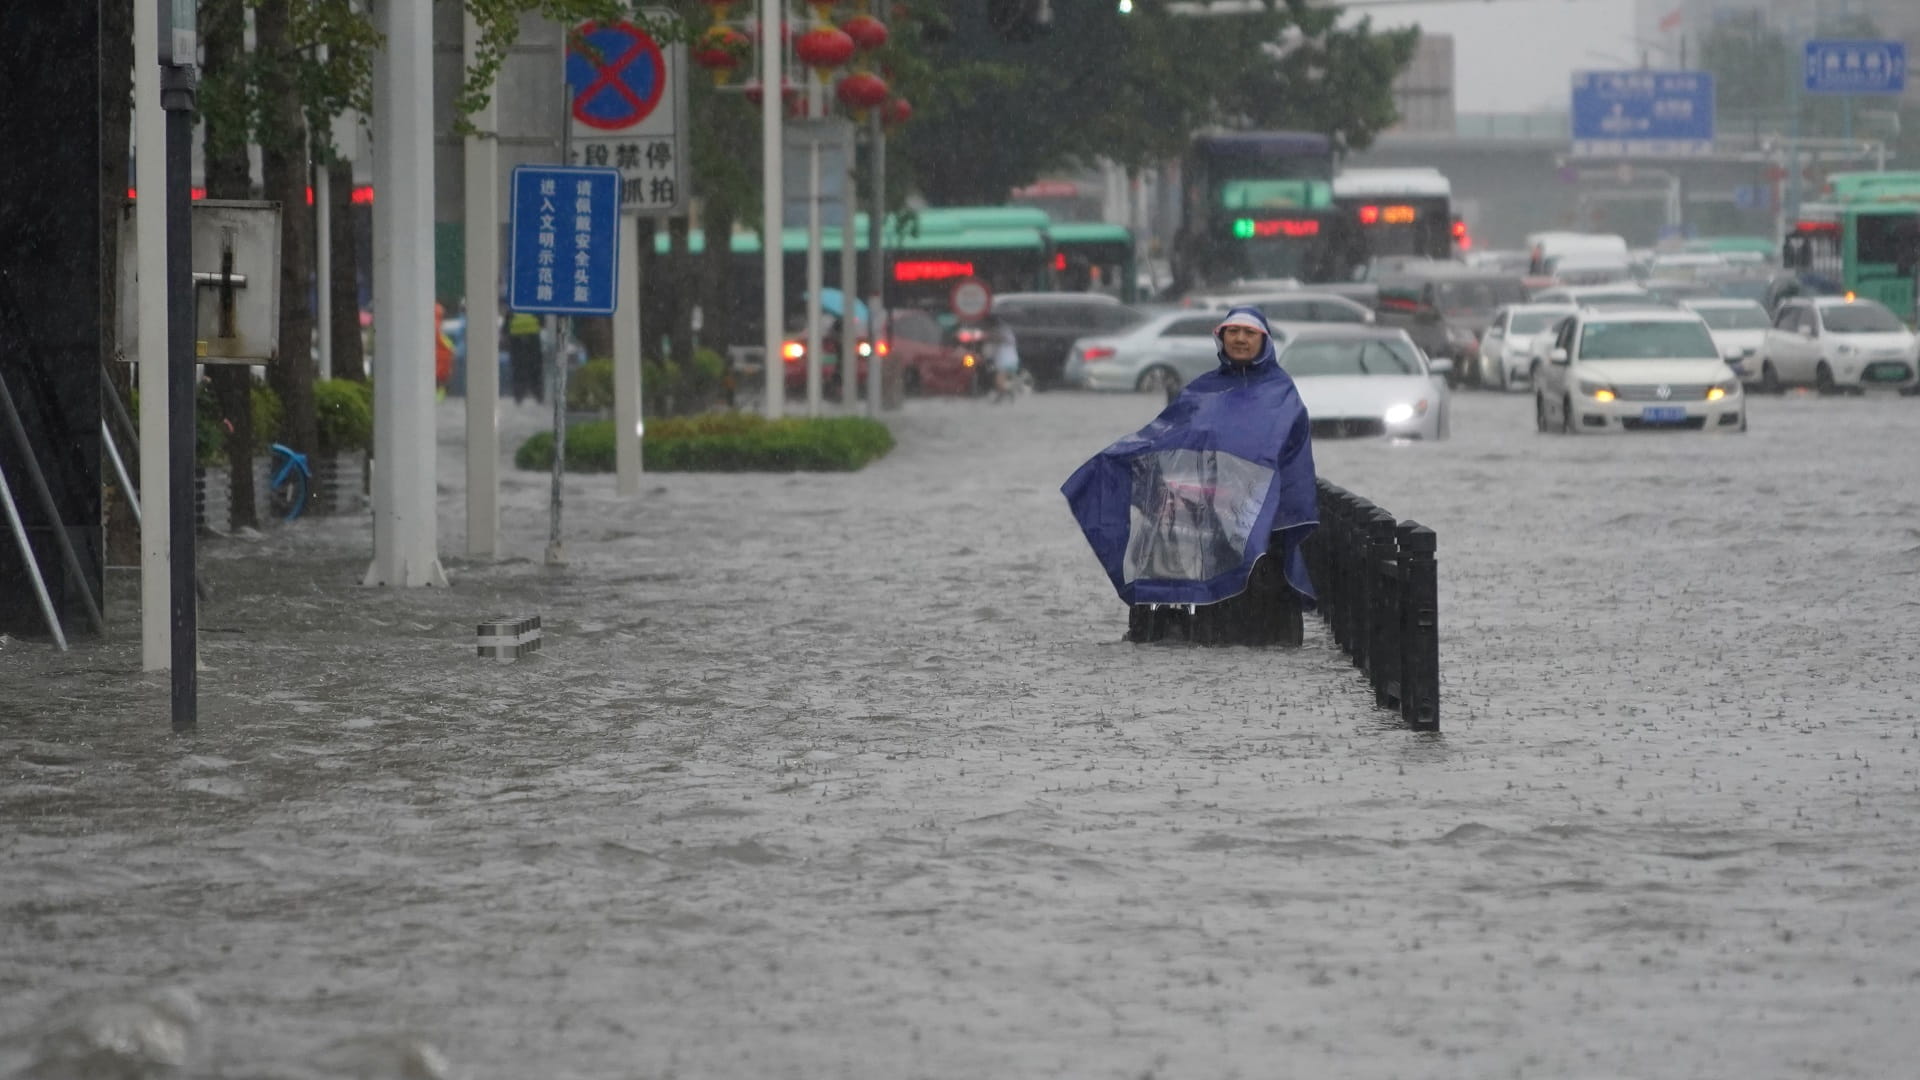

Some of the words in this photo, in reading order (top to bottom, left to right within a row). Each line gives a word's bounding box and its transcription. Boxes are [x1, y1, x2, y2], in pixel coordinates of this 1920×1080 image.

[537, 178, 556, 301] 进入文明示范路
